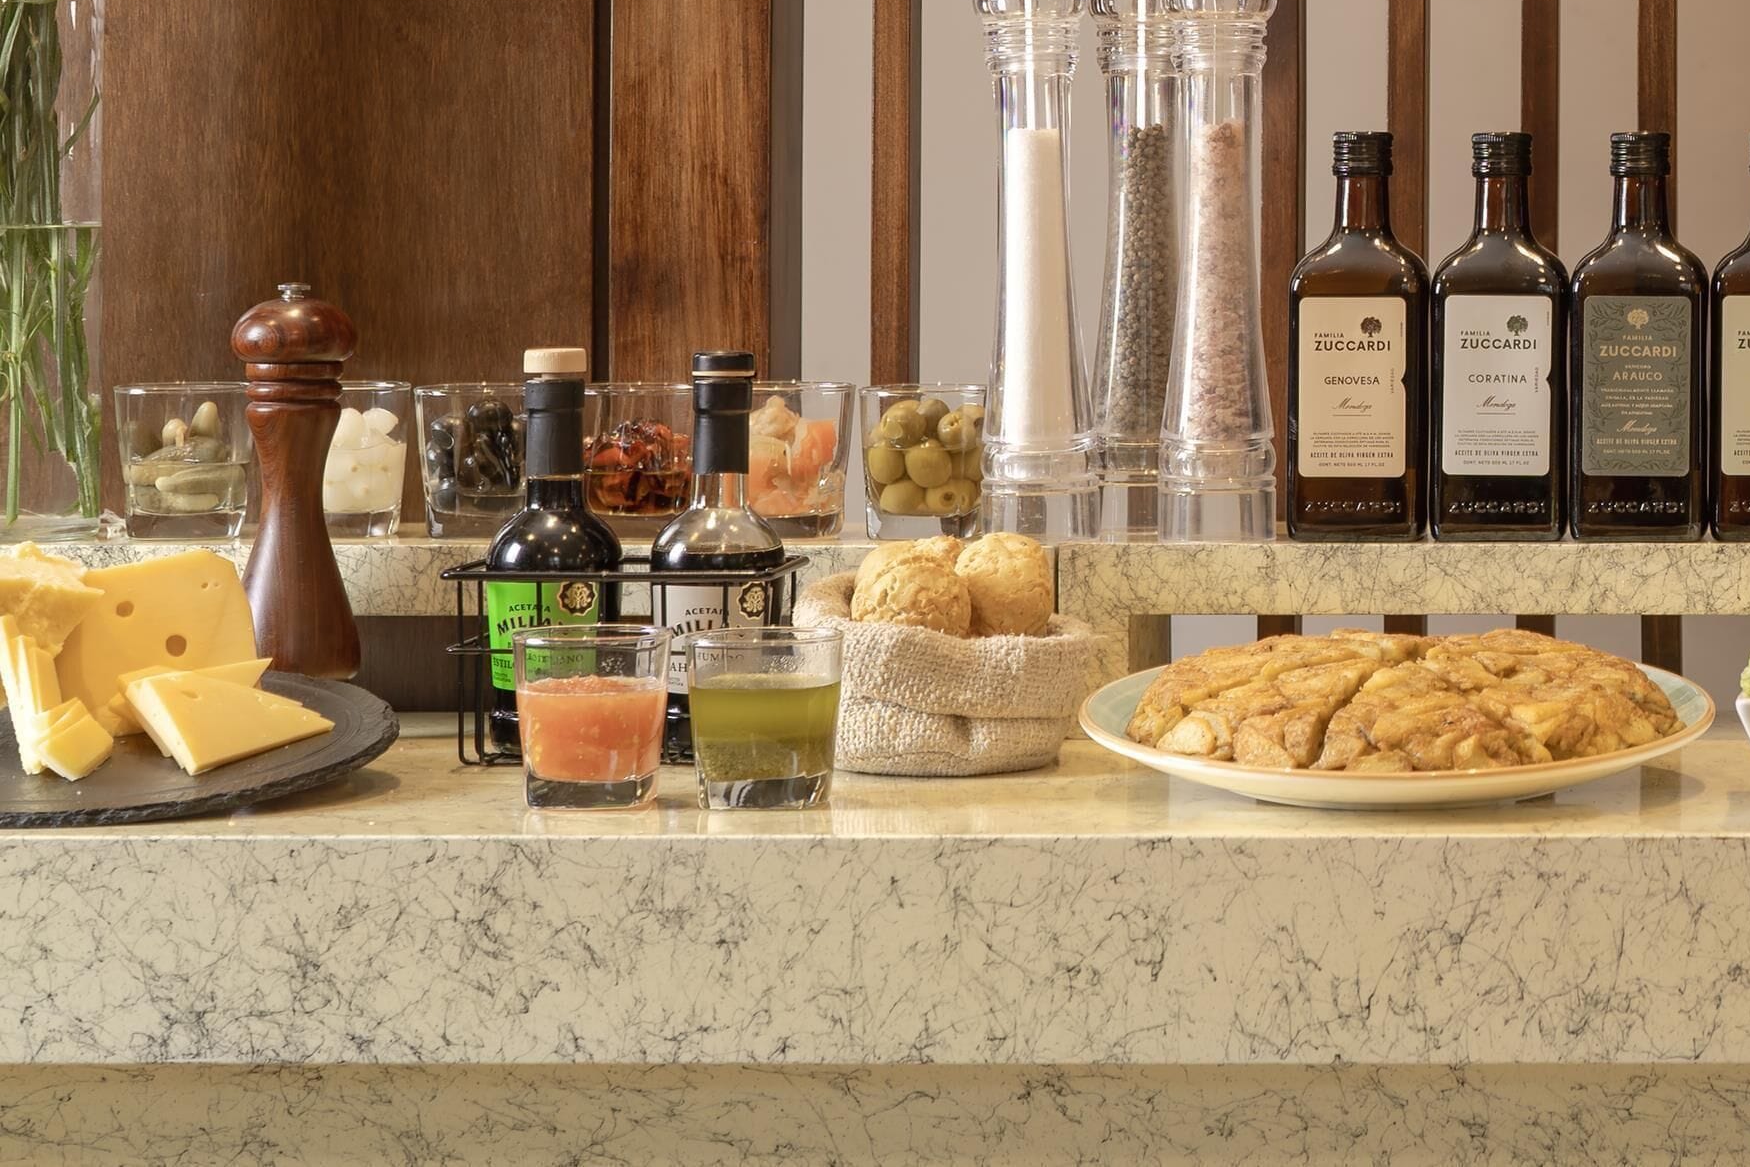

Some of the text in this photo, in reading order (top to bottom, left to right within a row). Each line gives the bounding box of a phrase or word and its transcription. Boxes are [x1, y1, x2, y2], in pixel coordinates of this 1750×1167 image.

[1314, 340, 1391, 351] ZUCCARDI
[1460, 339, 1537, 349] ZUCCARDI
[1600, 345, 1677, 357] ZUCCARDI
[1324, 376, 1380, 385] GENOVESA
[1468, 374, 1527, 383] CORATINA
[1612, 371, 1663, 381] ARAUCO
[1332, 397, 1372, 413] Mendoza
[1476, 394, 1516, 411] Mendoza
[1304, 501, 1401, 513] ZUCCARDI
[1448, 501, 1546, 513] ZUCCARDI
[1588, 501, 1685, 513] ZUCCARDI
[509, 604, 551, 612] ACETAA
